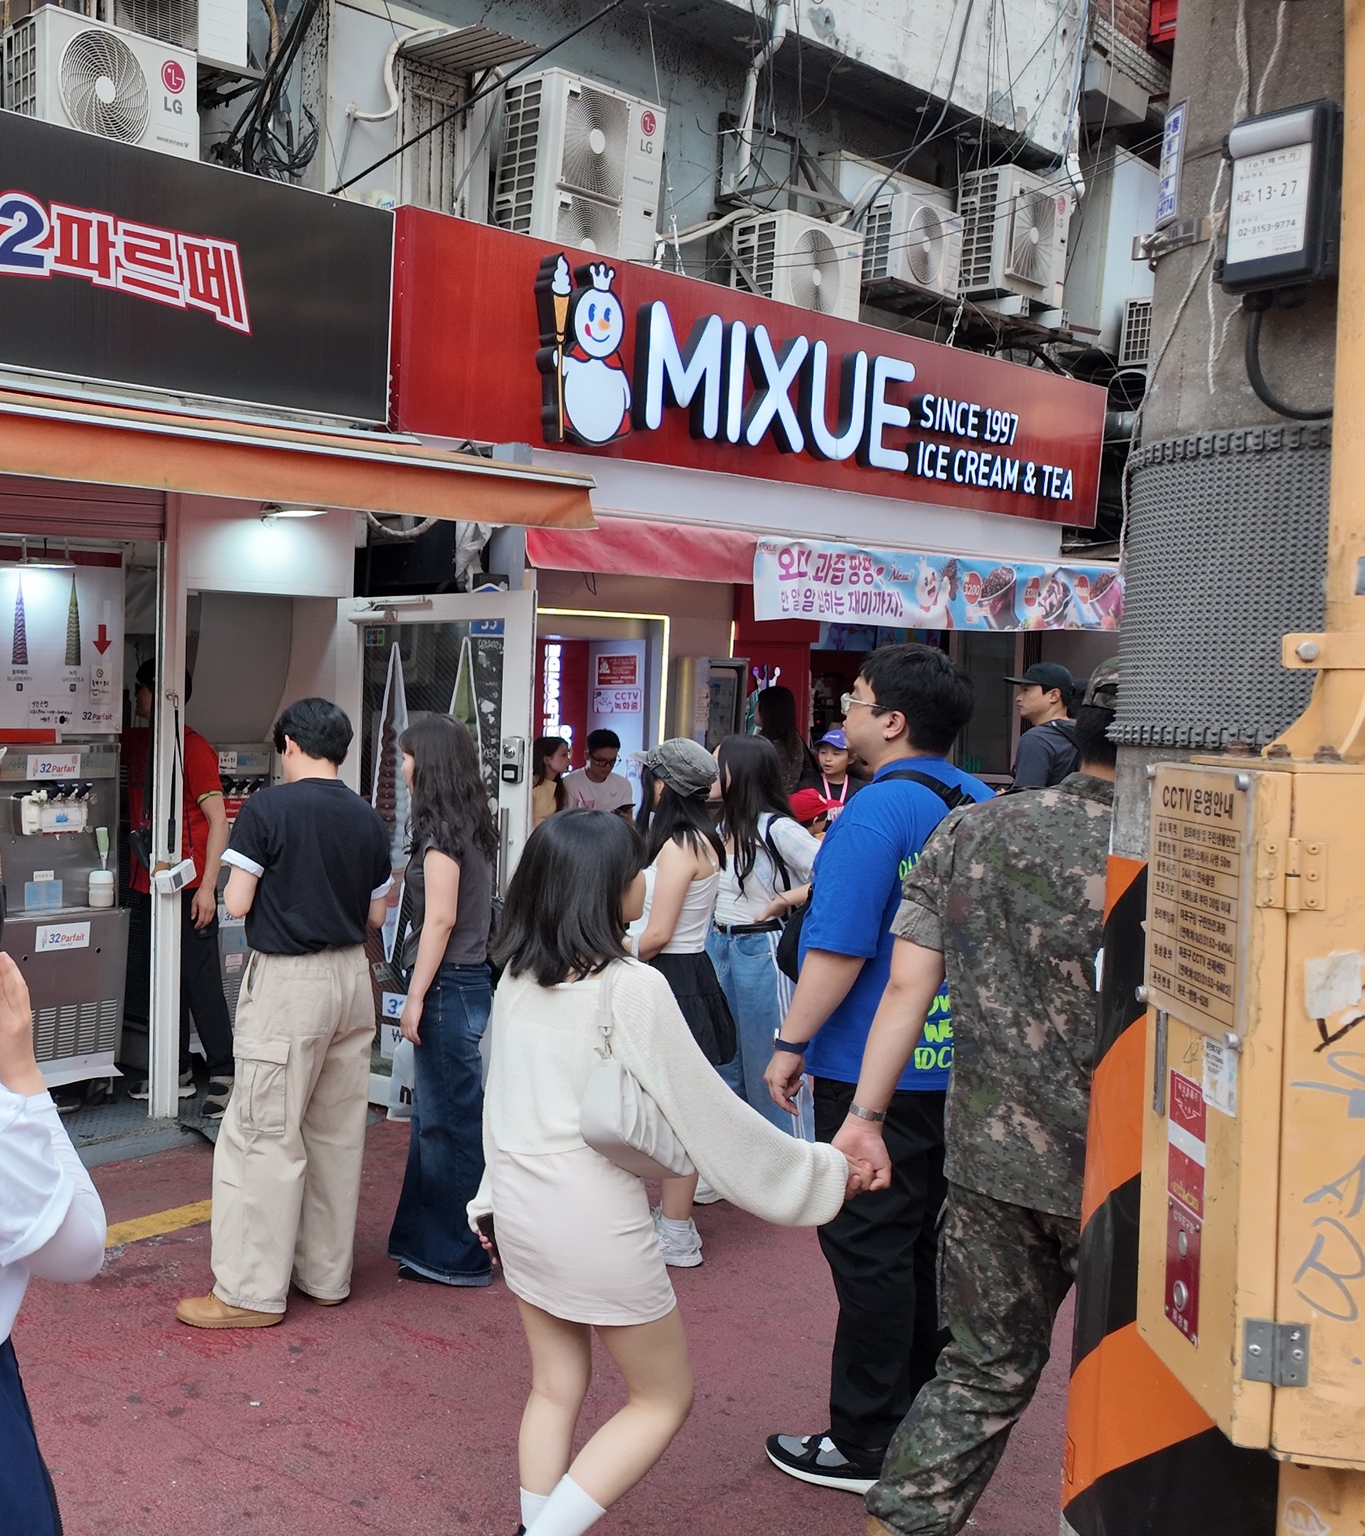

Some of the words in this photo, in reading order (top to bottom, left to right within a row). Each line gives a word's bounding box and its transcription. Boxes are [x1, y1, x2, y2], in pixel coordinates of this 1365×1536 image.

[164, 96, 183, 116] LG
[640, 139, 653, 154] LG
[1237, 219, 1296, 237] 02-3153-9774
[641, 299, 917, 474] MIXUE
[920, 393, 981, 439] SINCE
[984, 407, 1019, 446] 1997
[917, 440, 951, 480] ICE
[953, 449, 1020, 492] CREAM
[1023, 461, 1037, 495] &
[1042, 464, 1074, 500] TEA
[888, 565, 914, 583] New!
[963, 584, 980, 596] 3200
[543, 644, 562, 737] RLDWIDE
[614, 692, 639, 701] CCTV
[49, 933, 85, 944] 32Parfait
